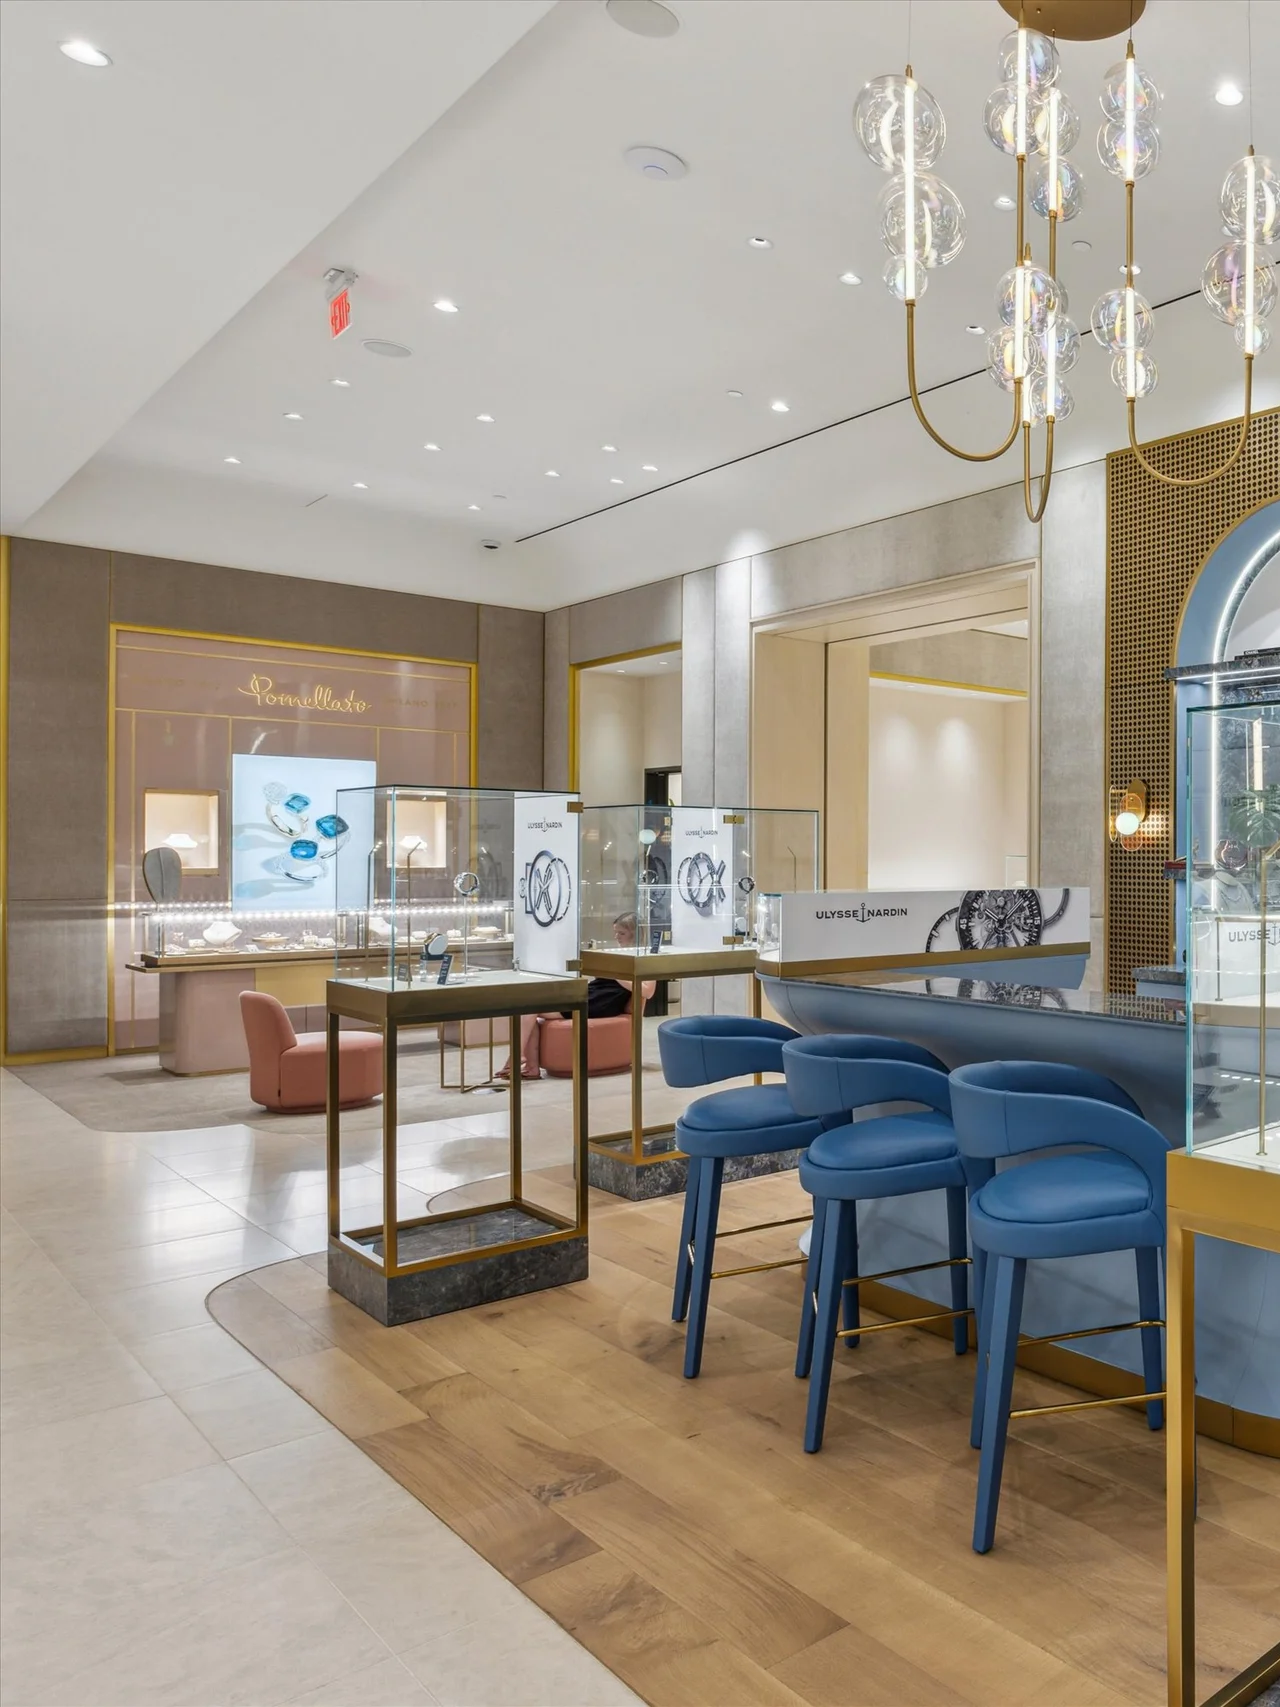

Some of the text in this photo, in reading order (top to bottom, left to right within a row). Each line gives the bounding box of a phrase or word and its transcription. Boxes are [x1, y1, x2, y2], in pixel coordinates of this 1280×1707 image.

[238, 674, 372, 713] Pomellato
[527, 821, 563, 829] ULYSSE NARDIN
[815, 907, 908, 920] ULYSSE NARDIN
[960, 918, 968, 930] 45
[1228, 929, 1271, 943] ULYSSE
